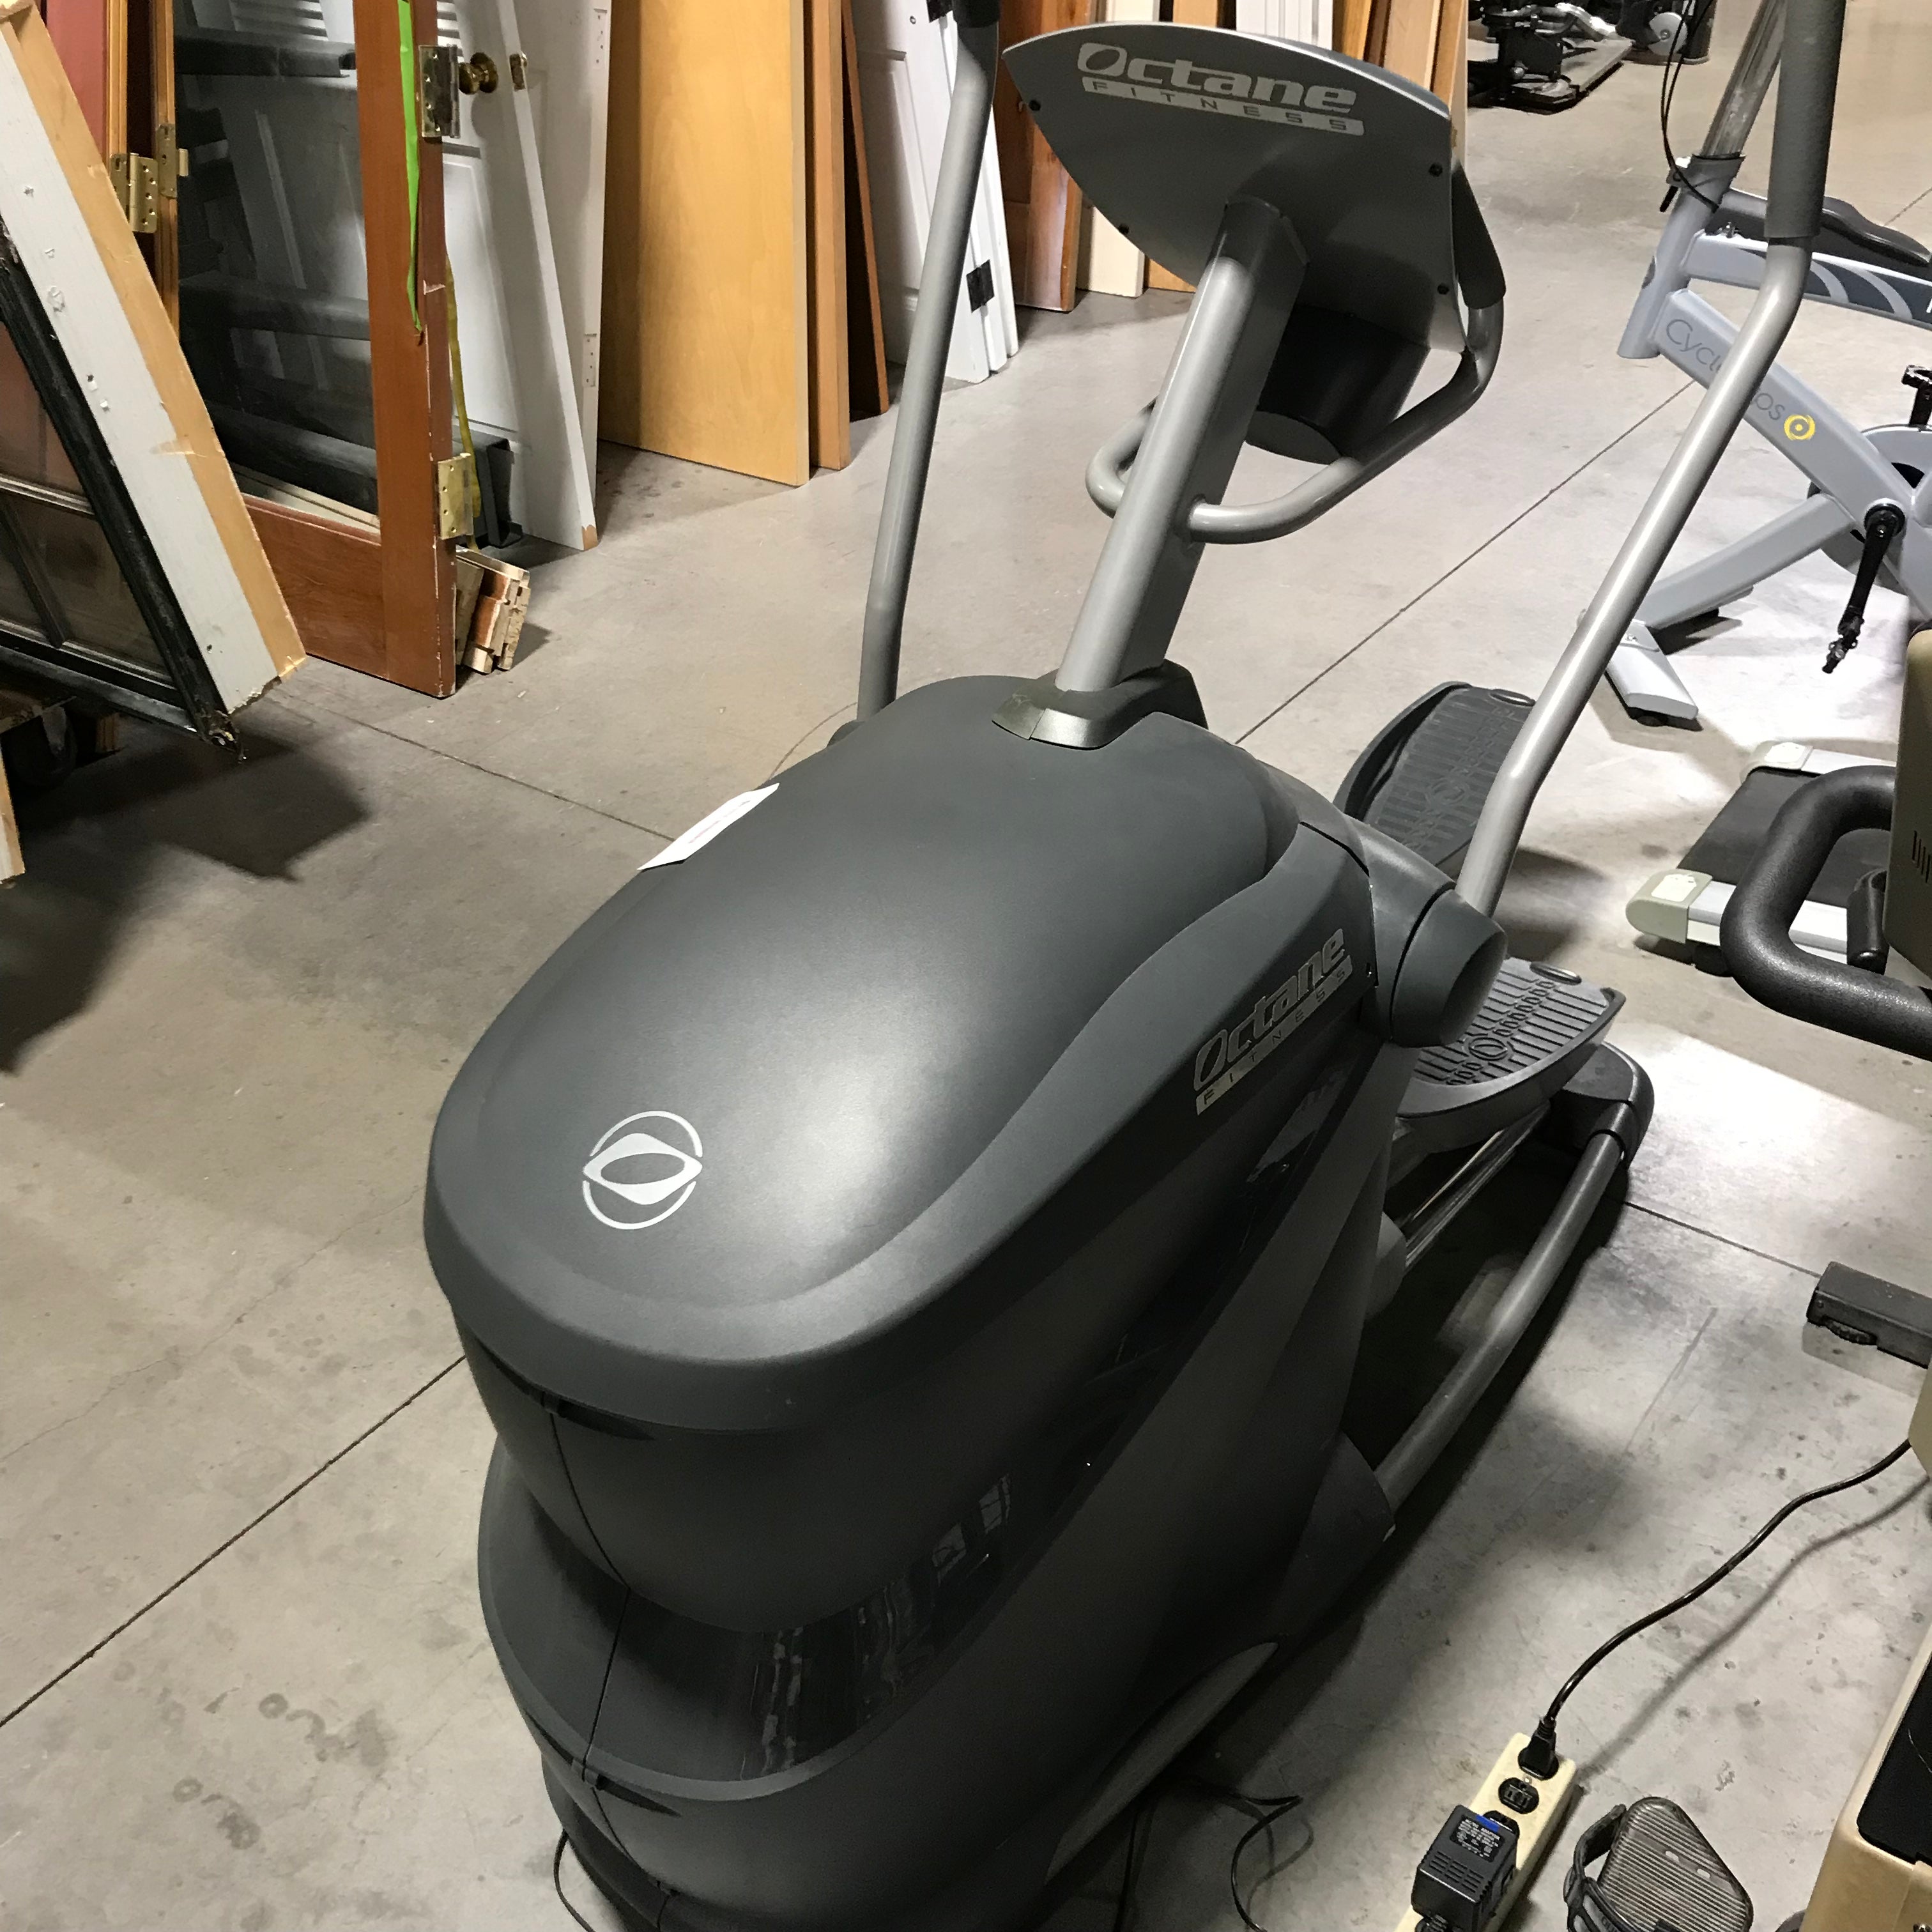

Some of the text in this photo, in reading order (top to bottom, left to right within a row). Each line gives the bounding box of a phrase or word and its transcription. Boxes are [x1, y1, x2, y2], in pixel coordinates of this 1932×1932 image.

[1078, 42, 1356, 113] Octane
[1089, 80, 1350, 132] FITNESS
[1193, 928, 1345, 1091] Octane
[1202, 968, 1347, 1107] FITNESS
